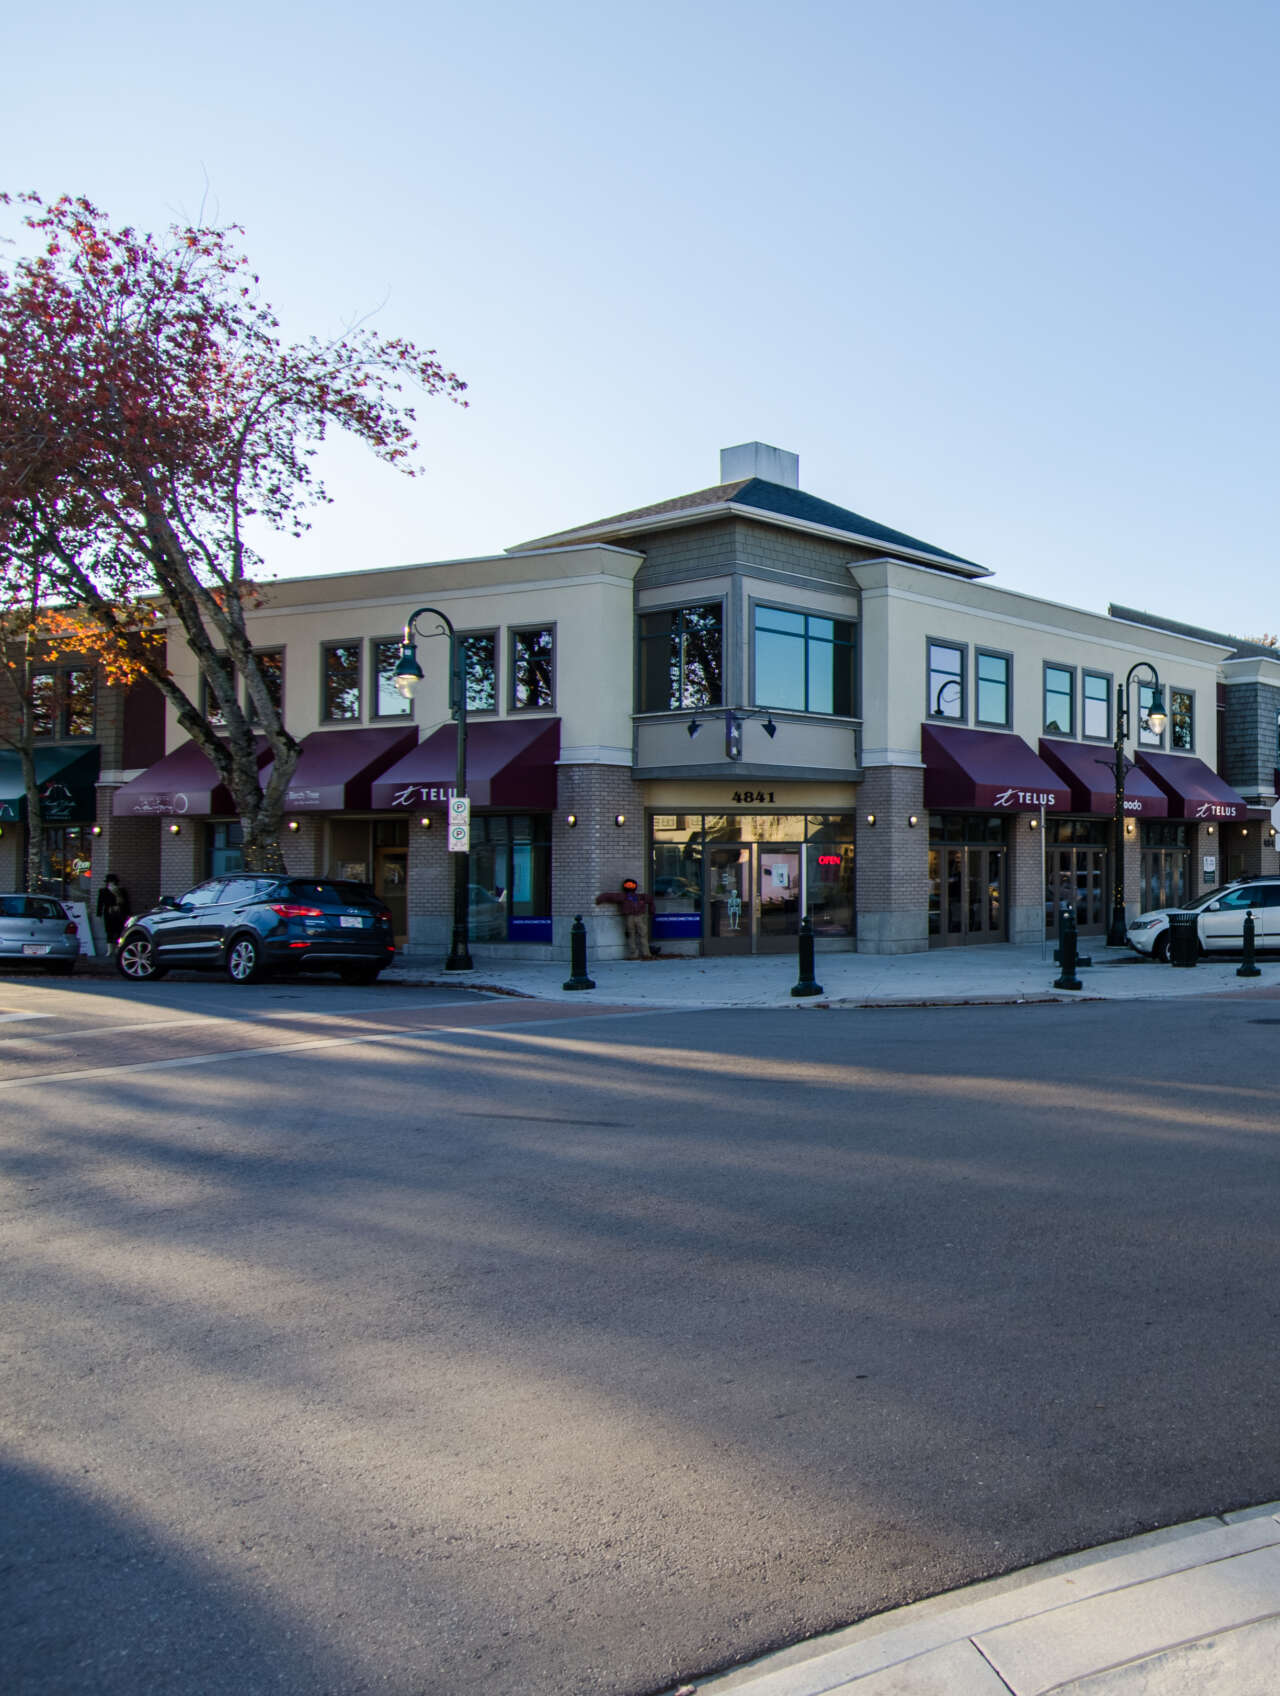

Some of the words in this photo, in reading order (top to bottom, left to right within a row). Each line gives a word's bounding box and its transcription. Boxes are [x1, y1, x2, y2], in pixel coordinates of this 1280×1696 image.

[420, 788, 458, 801] TELU
[732, 791, 776, 804] 4841
[1017, 791, 1055, 805] TELUS
[1211, 806, 1236, 817] TELUS
[818, 855, 841, 865] OPEN
